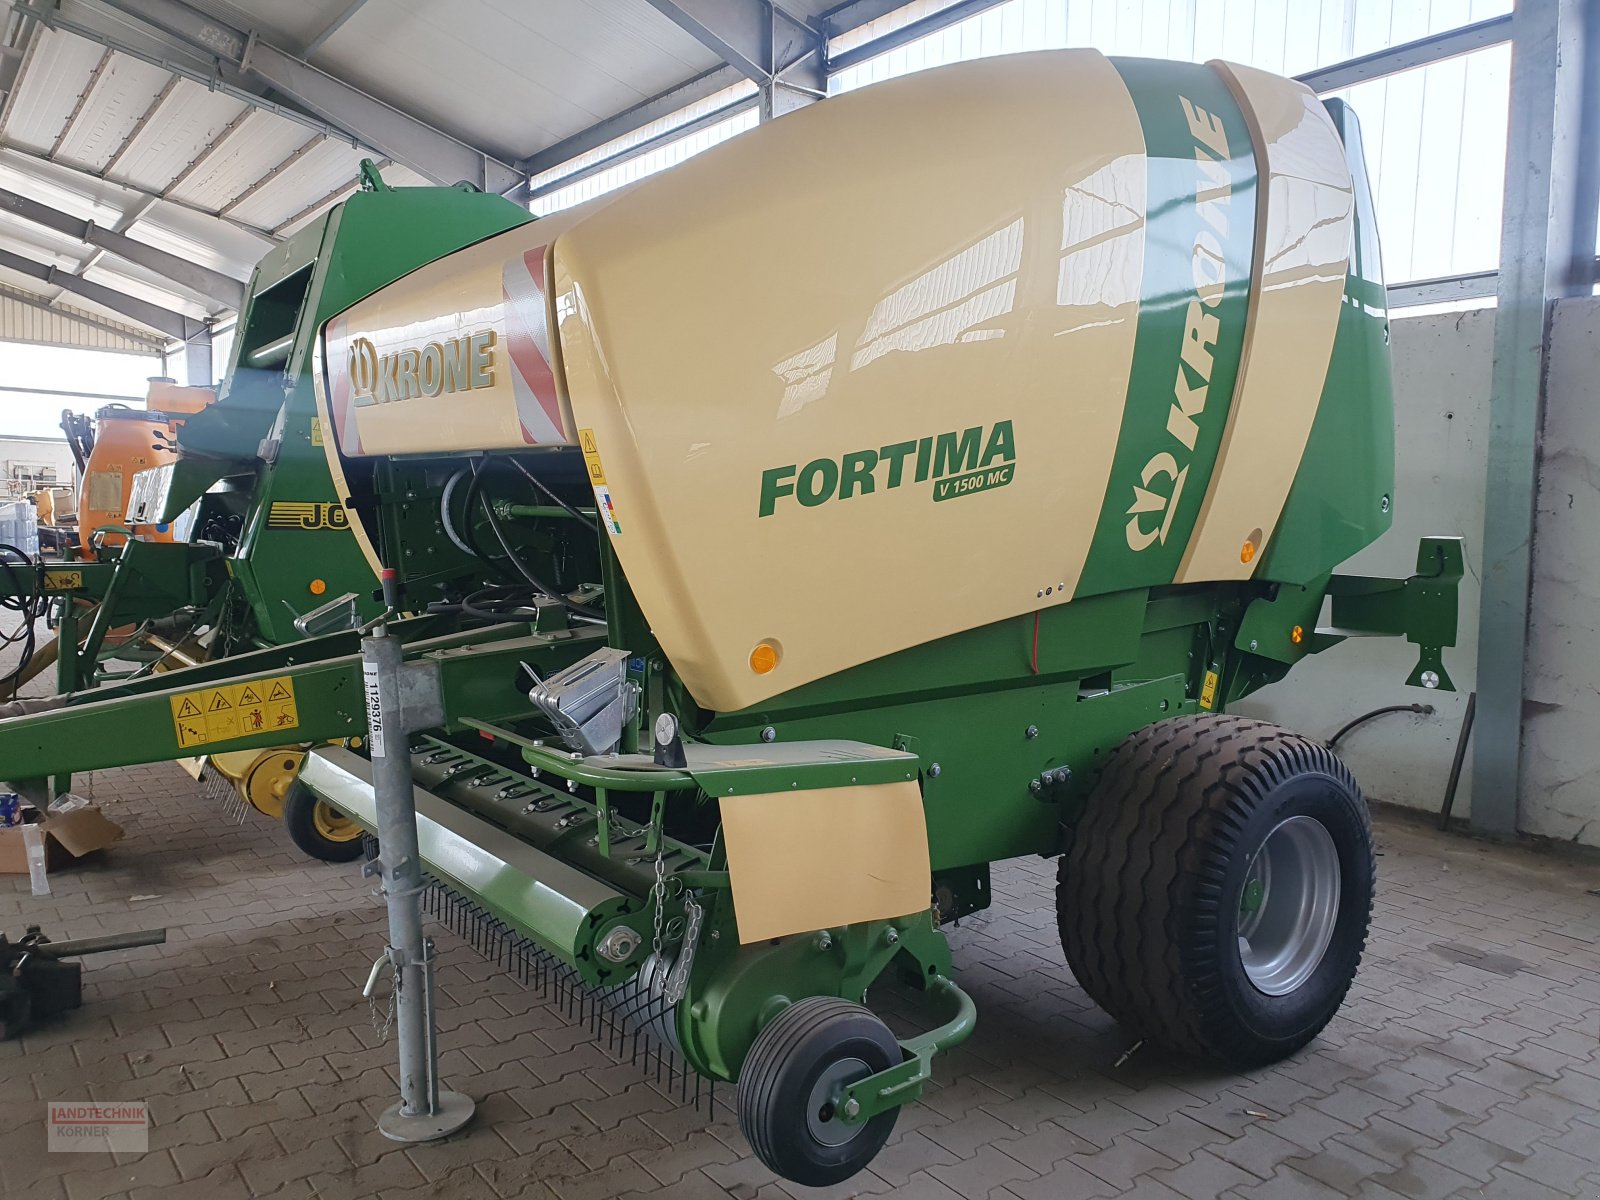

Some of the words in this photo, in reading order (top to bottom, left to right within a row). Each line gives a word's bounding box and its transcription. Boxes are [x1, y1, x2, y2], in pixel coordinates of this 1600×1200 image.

[1166, 94, 1231, 452] KRONE
[378, 330, 497, 403] KRONE
[758, 419, 1016, 518] FORTIMA
[940, 482, 950, 496] V
[953, 474, 984, 493] 1500
[986, 468, 1009, 486] MC
[369, 682, 382, 732] 1129376
